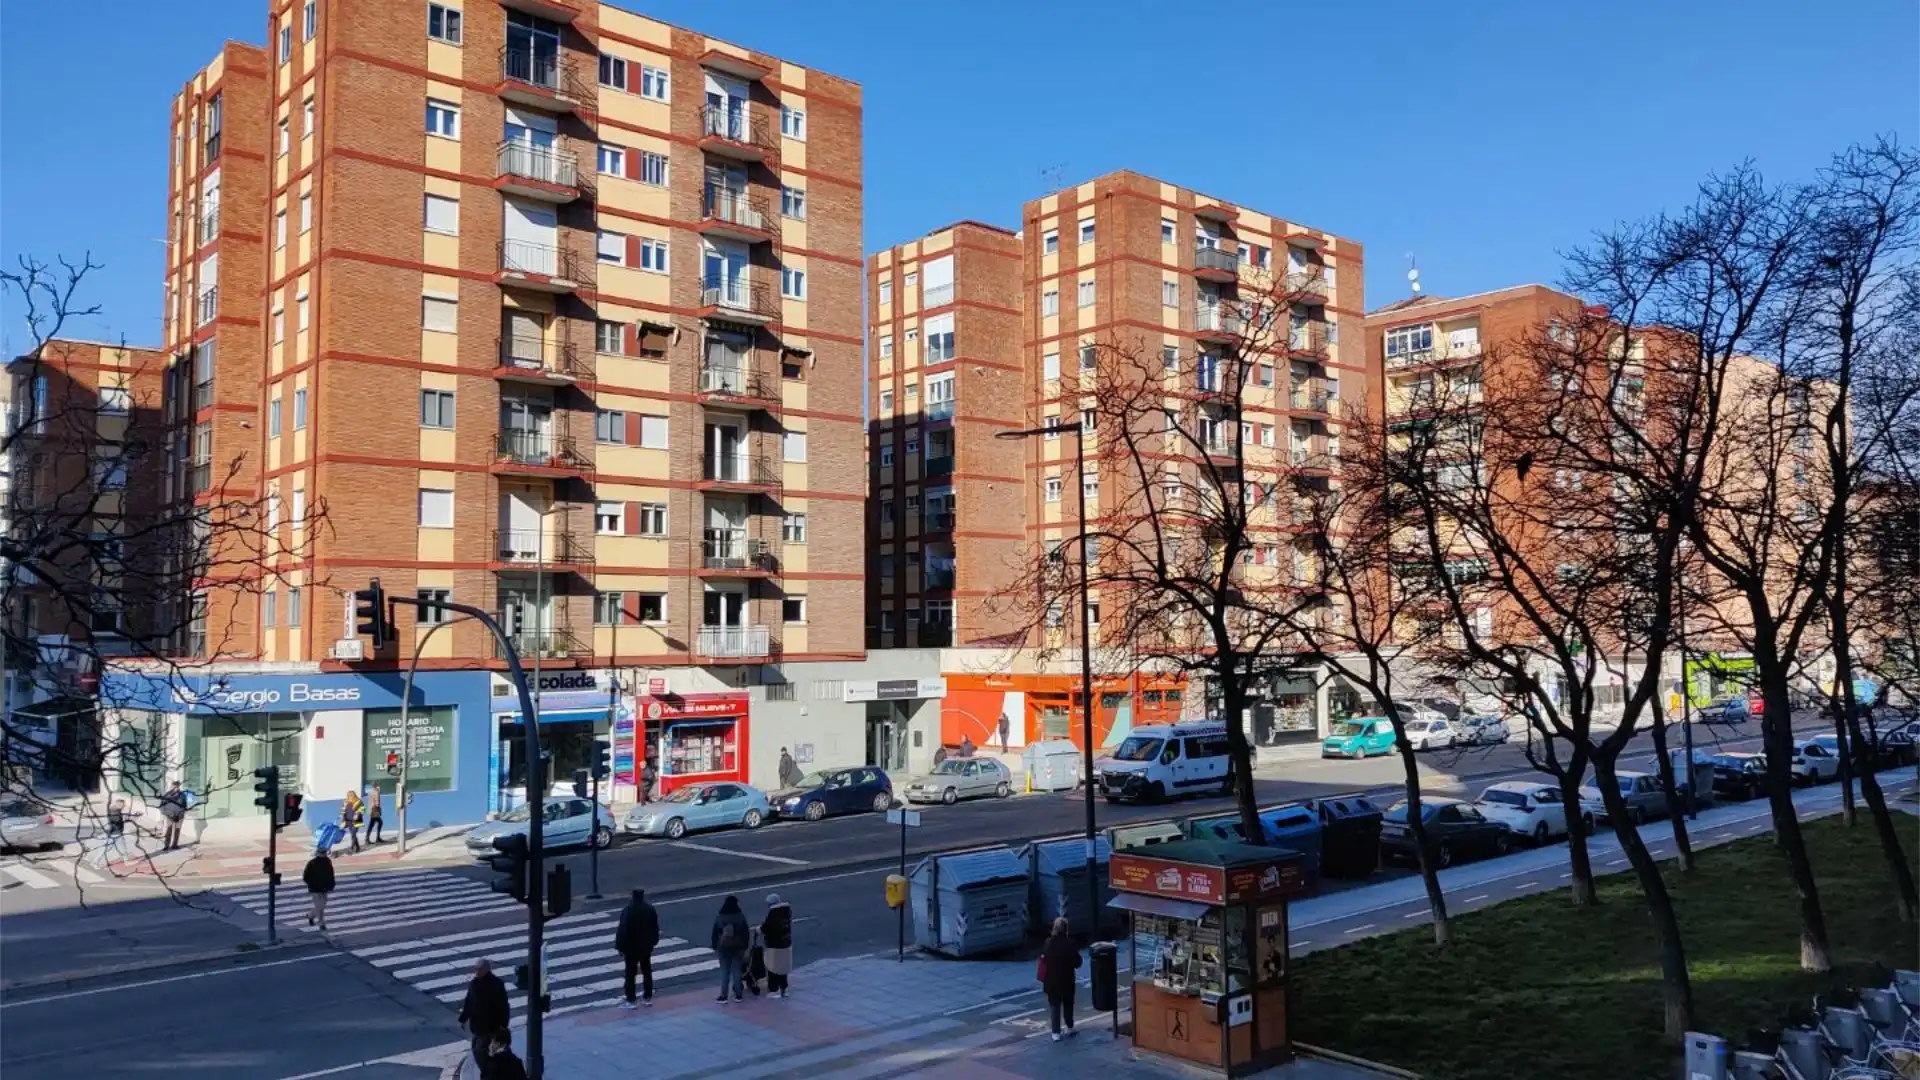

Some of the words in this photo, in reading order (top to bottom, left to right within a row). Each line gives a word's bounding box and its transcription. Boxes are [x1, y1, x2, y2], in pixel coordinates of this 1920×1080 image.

[521, 672, 596, 689] acolada
[209, 683, 281, 708] Sergio
[290, 683, 361, 702] Basas
[388, 718, 429, 726] HOARIO
[371, 728, 387, 736] SIN
[390, 727, 409, 736] CIT
